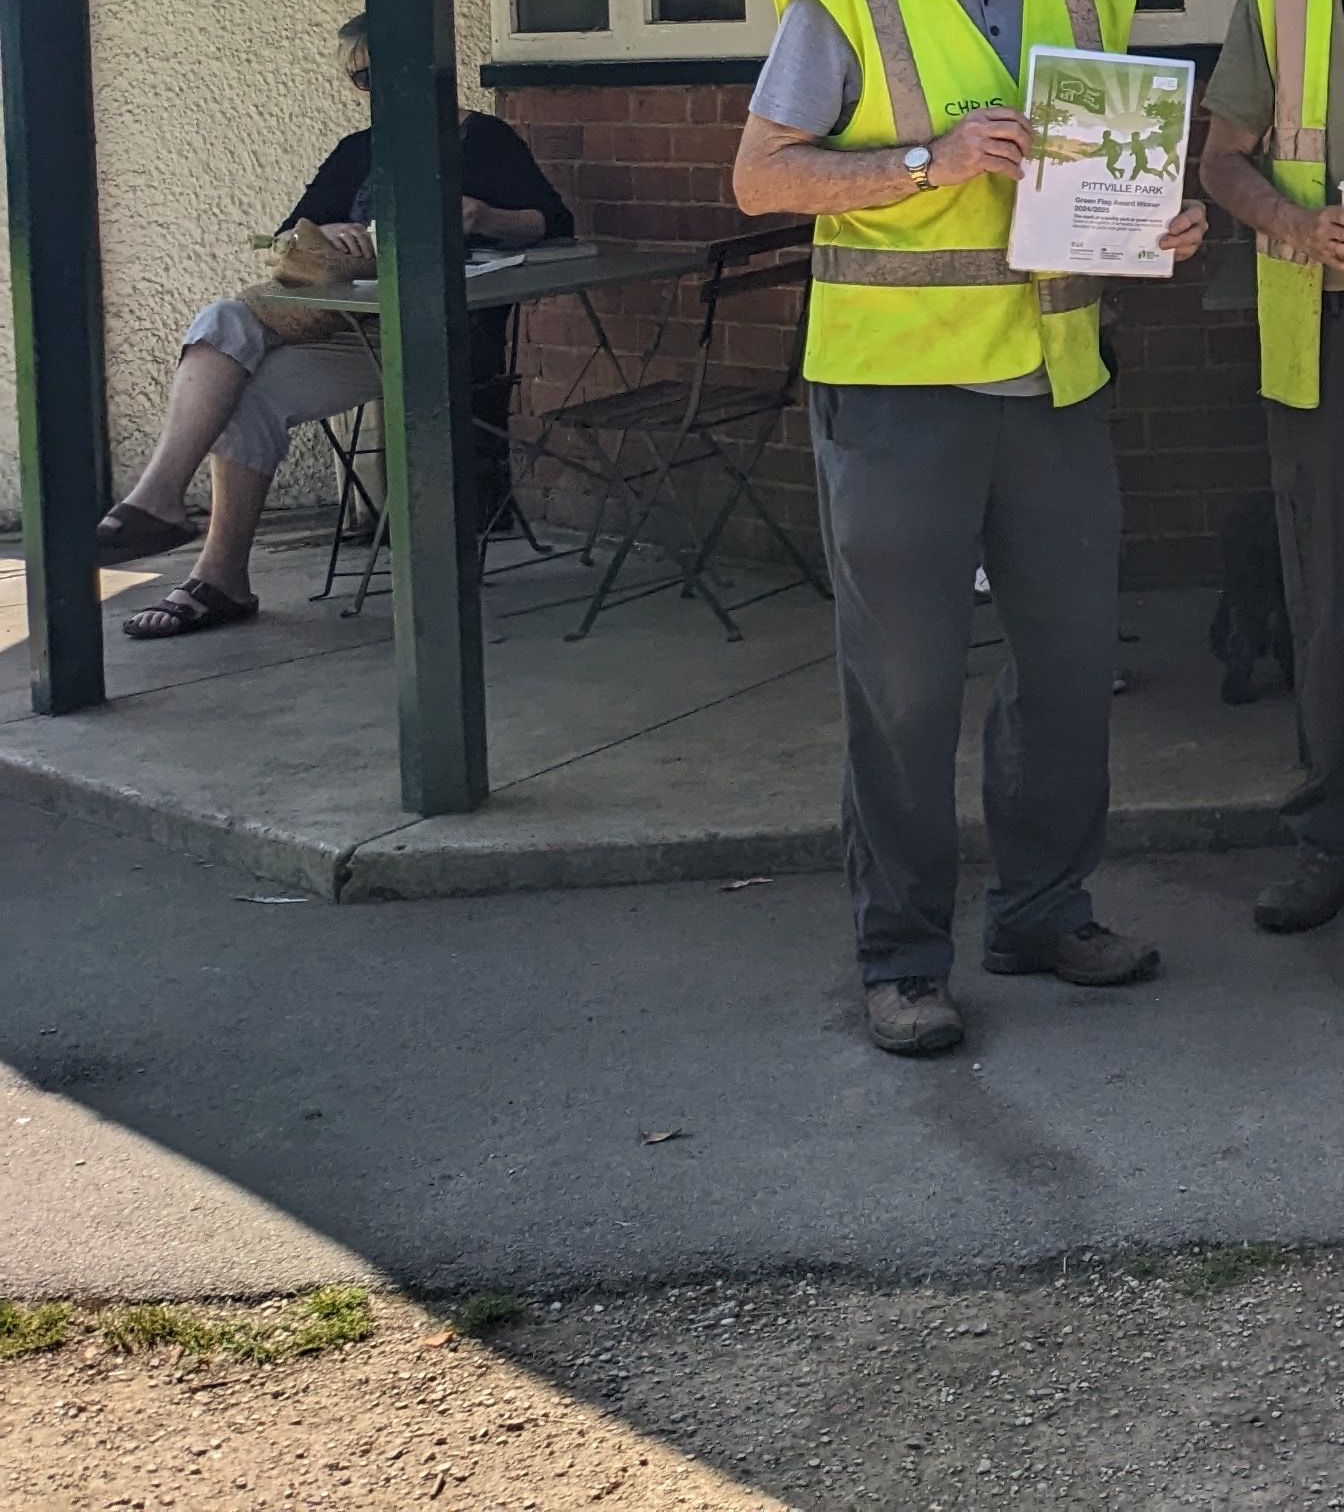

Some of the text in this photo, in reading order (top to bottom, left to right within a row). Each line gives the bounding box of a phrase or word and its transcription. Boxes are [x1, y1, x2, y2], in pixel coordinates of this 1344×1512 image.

[1081, 181, 1163, 195] PITTVILLE PARK
[1074, 196, 1096, 205] Green
[1097, 198, 1112, 206] Flag
[1113, 199, 1136, 207] Award
